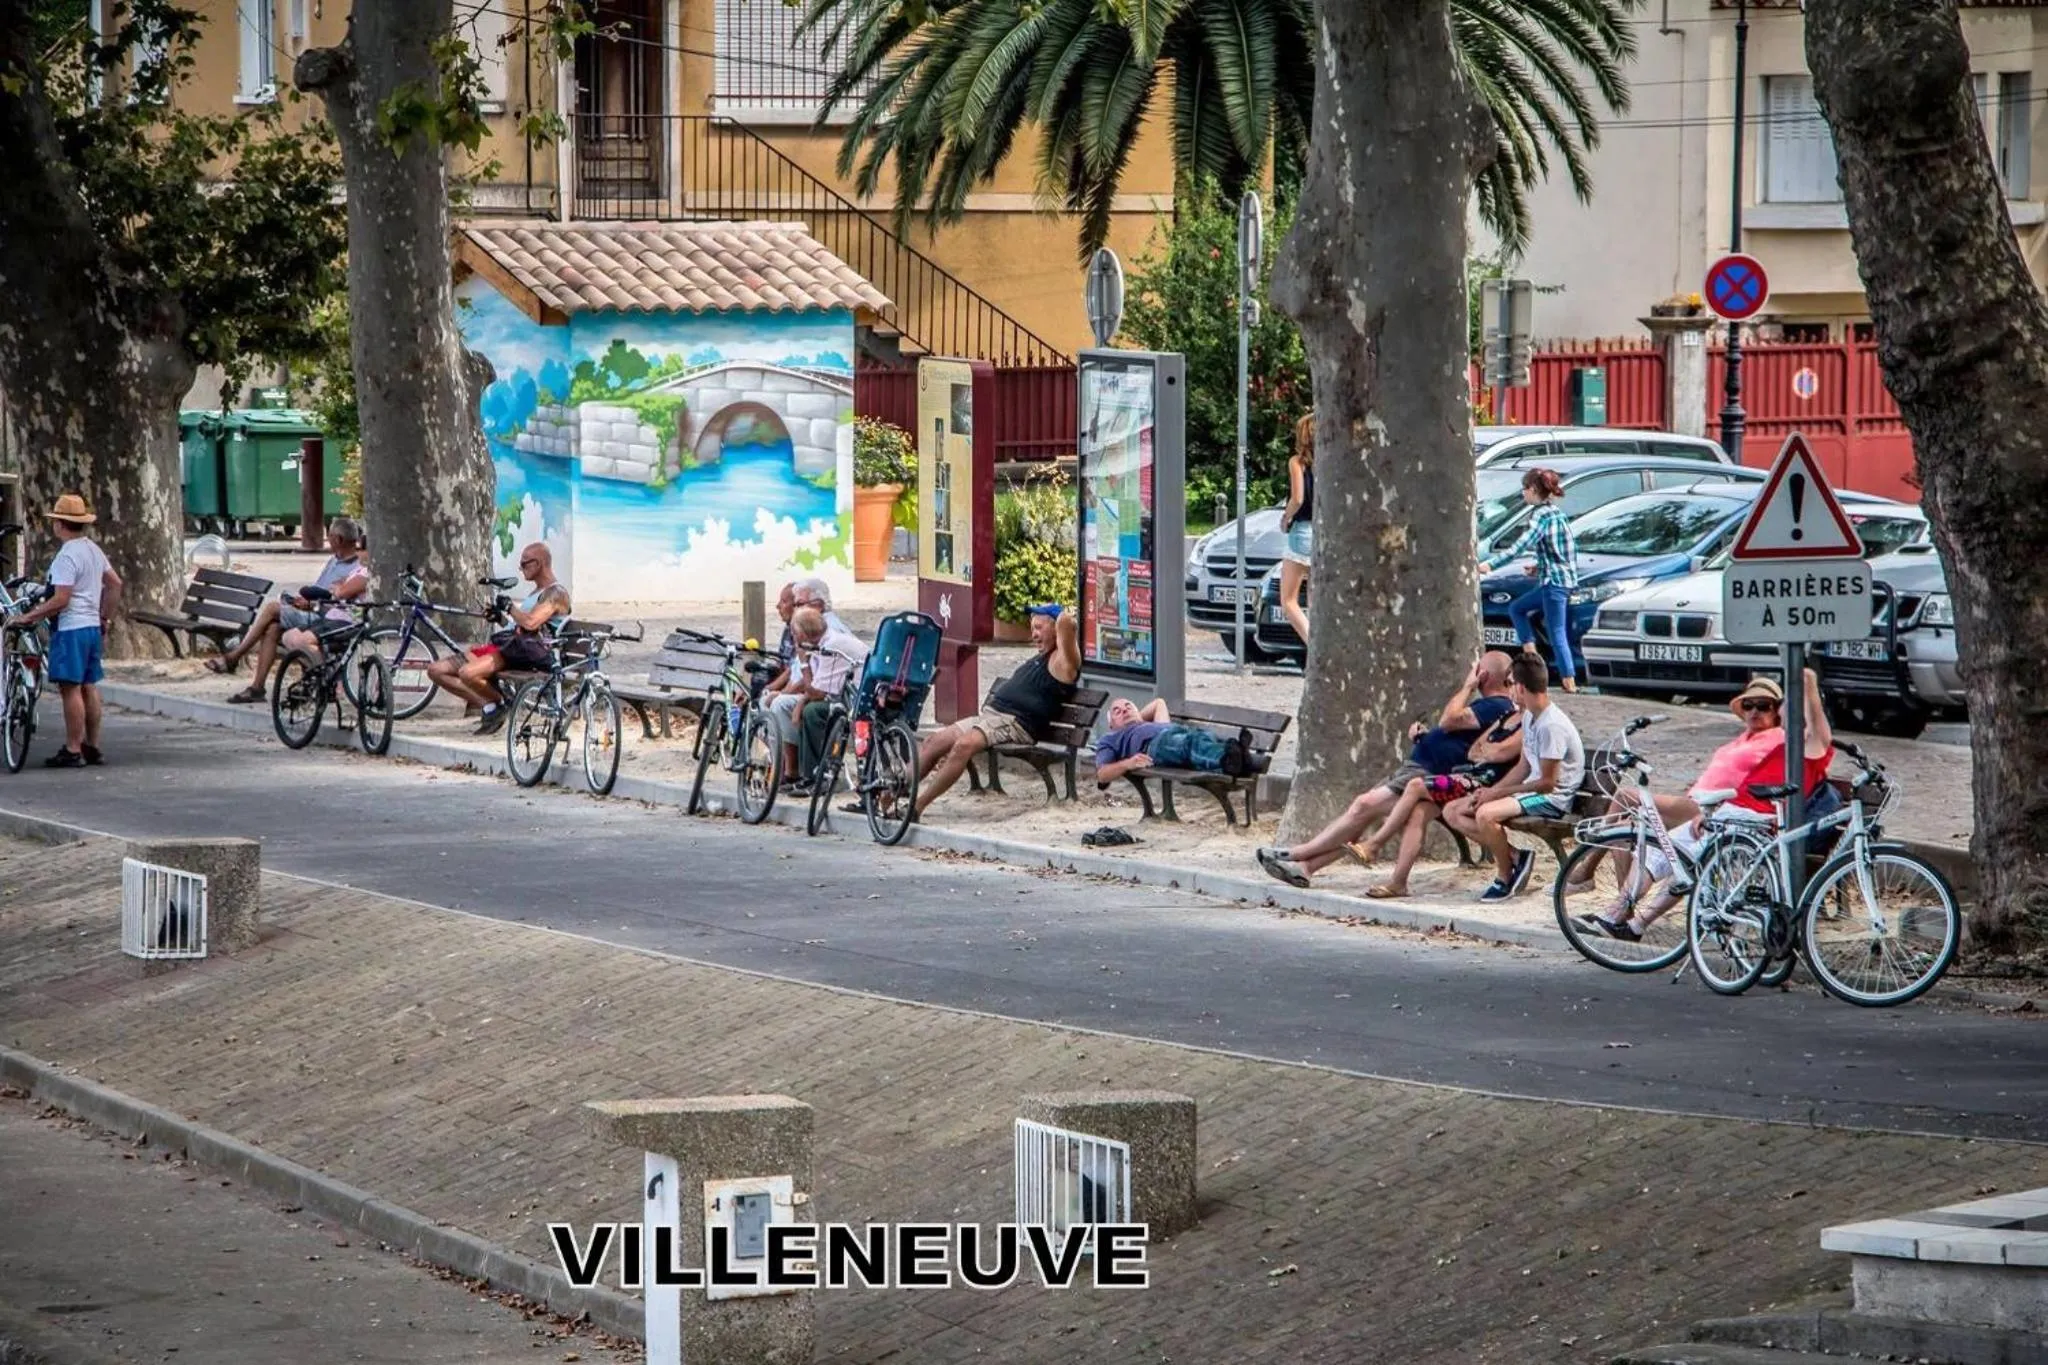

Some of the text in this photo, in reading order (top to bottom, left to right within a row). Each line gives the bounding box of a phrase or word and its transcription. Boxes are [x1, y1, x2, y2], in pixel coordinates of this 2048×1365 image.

[1732, 573, 1864, 599] BARRIÈRES
[1762, 604, 1836, 627] À 50m
